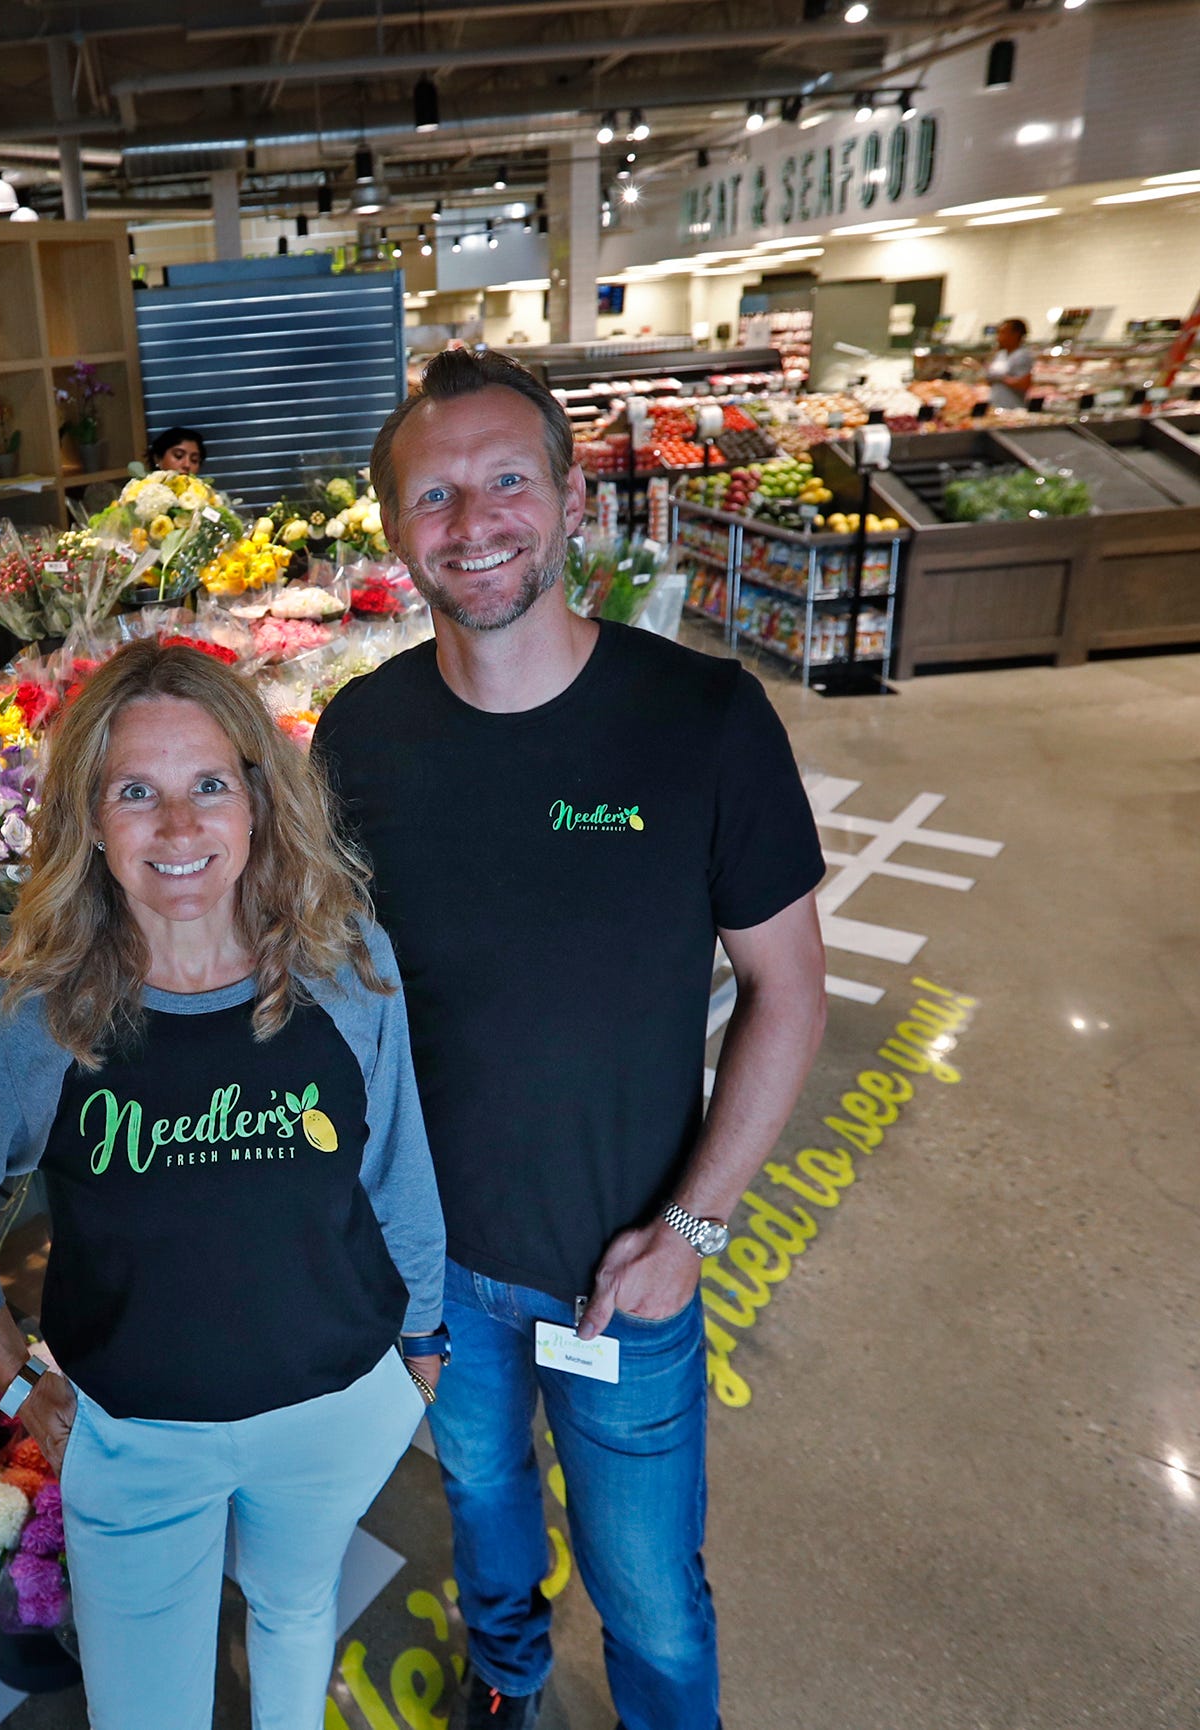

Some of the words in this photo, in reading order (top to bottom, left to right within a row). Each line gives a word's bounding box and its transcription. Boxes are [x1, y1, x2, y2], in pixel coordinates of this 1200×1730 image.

[679, 173, 743, 244] MEAT
[751, 164, 770, 228] &
[779, 116, 936, 225] SEAFOOD
[548, 799, 629, 831] Needler's
[79, 1083, 302, 1176] Needler's
[763, 1147, 856, 1207] to
[822, 1069, 915, 1155] see
[878, 976, 978, 1084] you!
[166, 1149, 218, 1168] FRESH
[231, 1147, 296, 1161] MARKET
